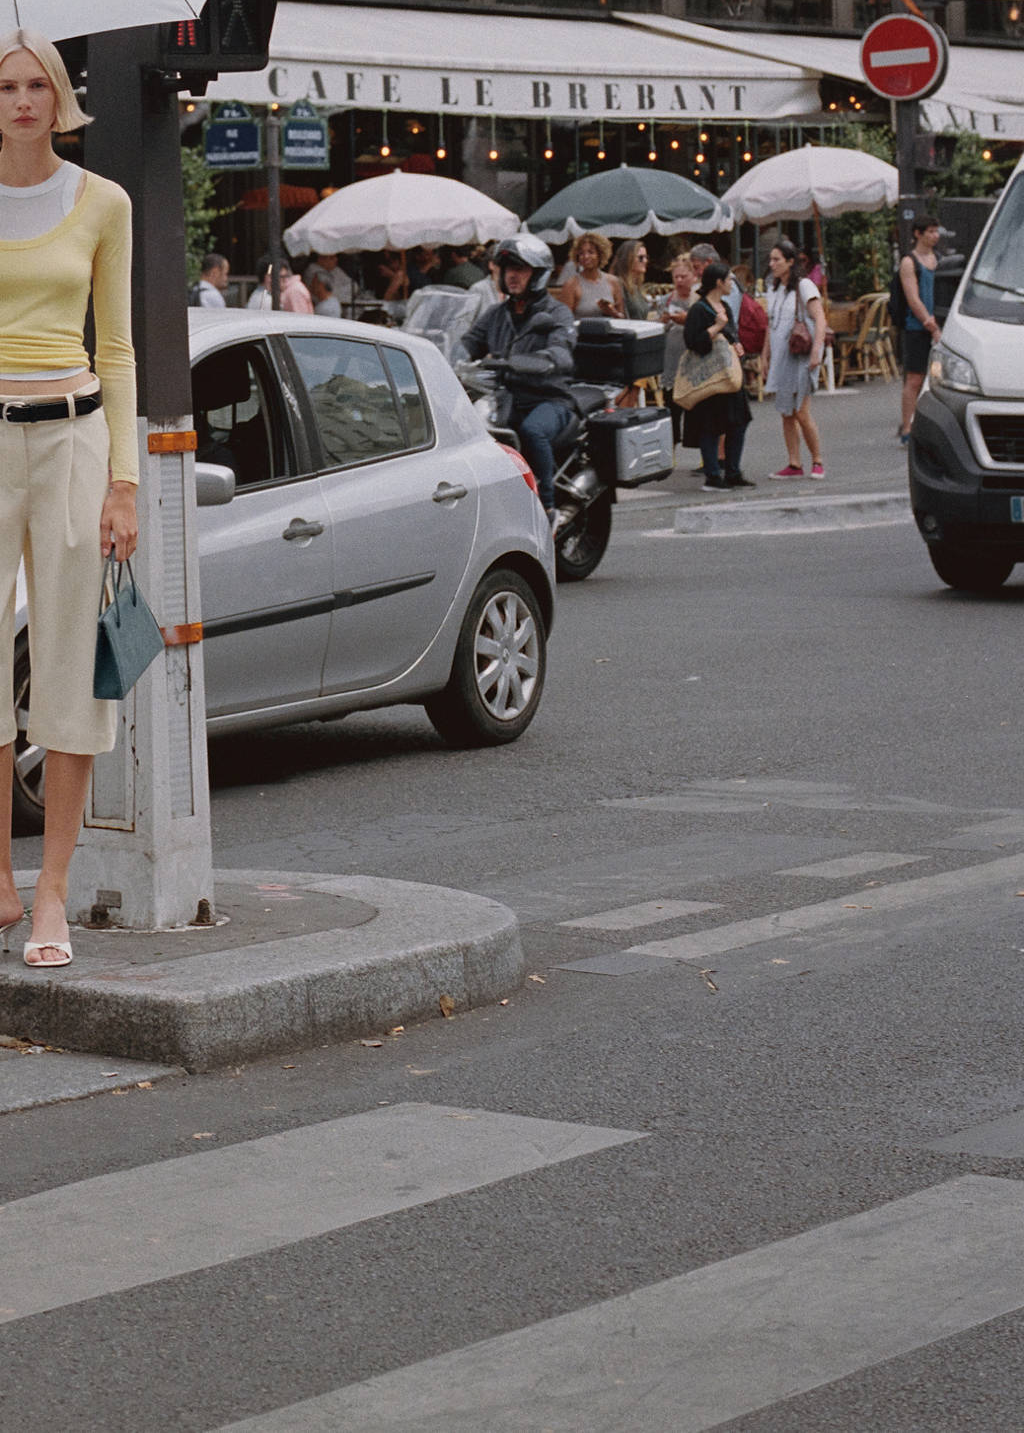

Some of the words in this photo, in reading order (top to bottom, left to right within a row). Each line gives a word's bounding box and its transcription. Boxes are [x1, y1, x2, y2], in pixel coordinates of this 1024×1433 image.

[267, 67, 402, 103] CAFE
[440, 76, 494, 107] LE
[531, 80, 747, 111] BREBANT
